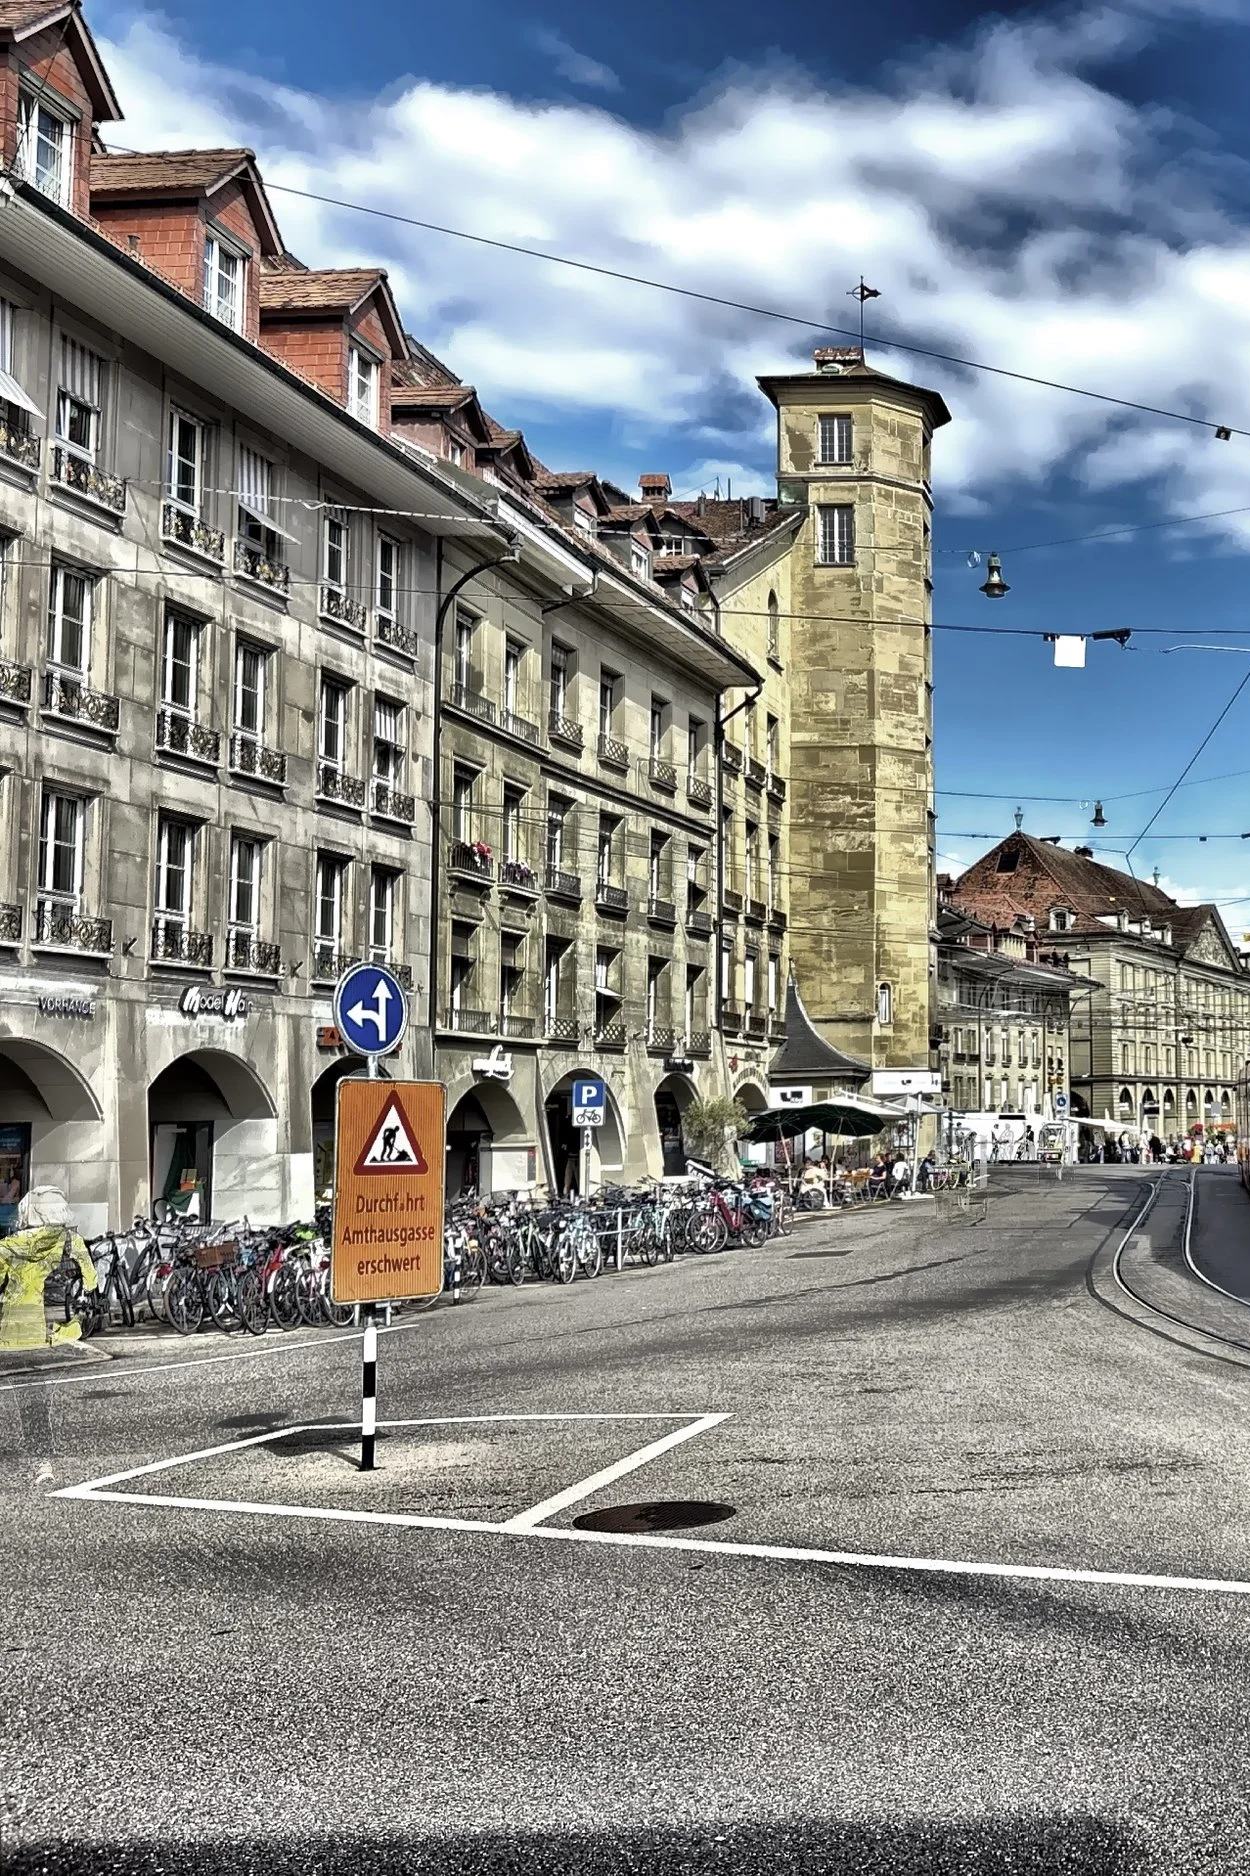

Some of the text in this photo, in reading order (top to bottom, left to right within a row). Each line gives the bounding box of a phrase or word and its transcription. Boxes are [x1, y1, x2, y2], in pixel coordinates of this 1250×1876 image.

[581, 1085, 598, 1105] P
[341, 1225, 435, 1248] Amthausgasse
[357, 1253, 421, 1276] erschwert
